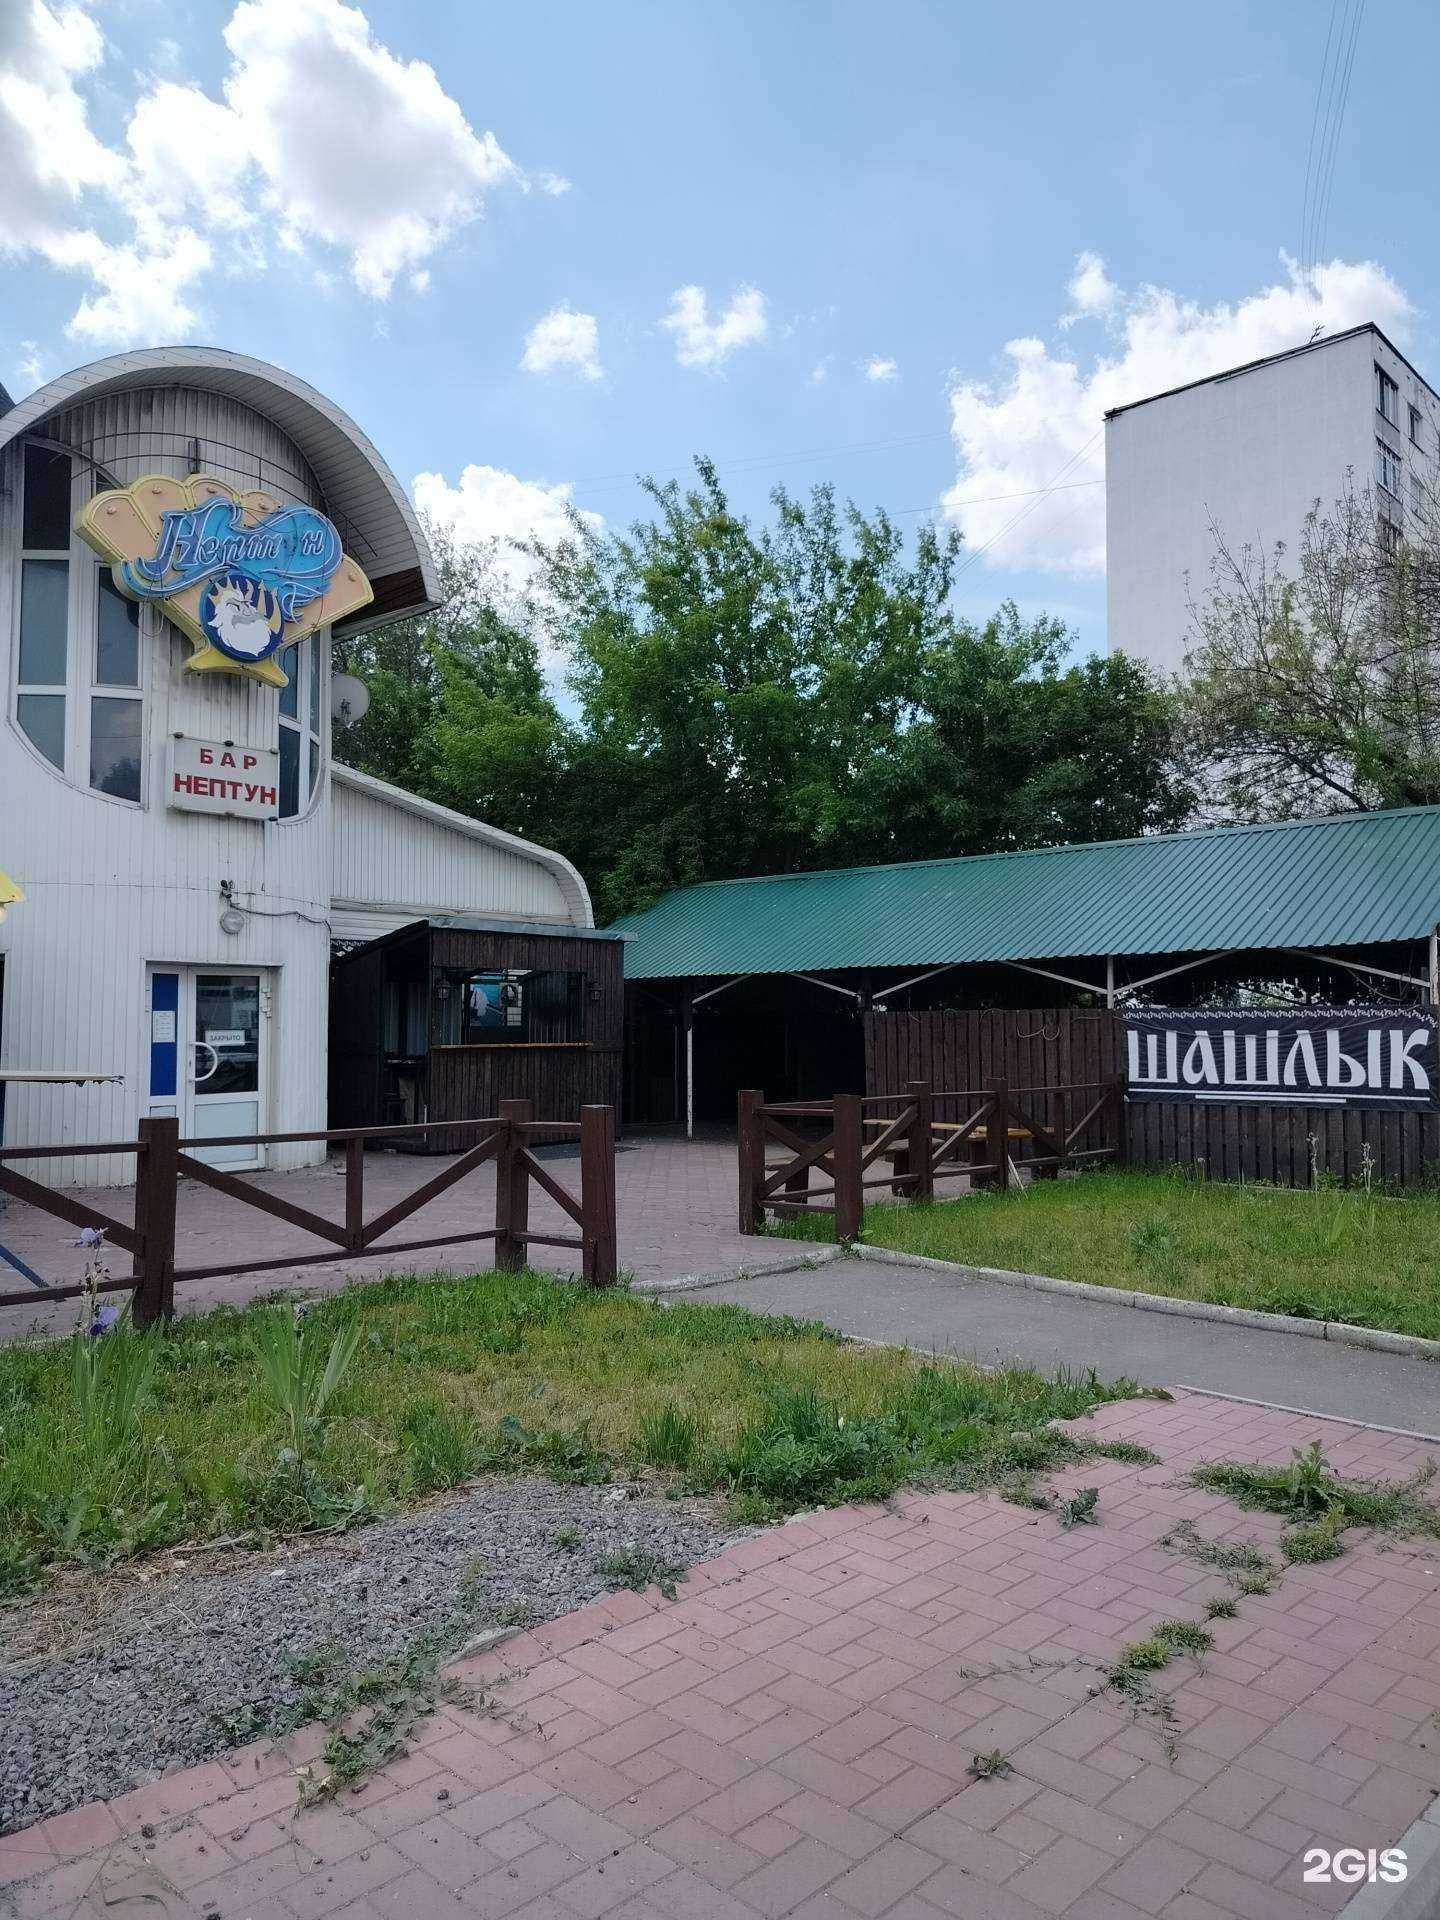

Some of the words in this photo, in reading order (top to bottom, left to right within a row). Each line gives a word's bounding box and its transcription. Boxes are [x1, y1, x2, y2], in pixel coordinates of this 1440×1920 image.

[200, 748, 257, 769] БАР
[174, 773, 277, 806] НЕПТУН
[1126, 1029, 1431, 1090] ШАШЛЫК
